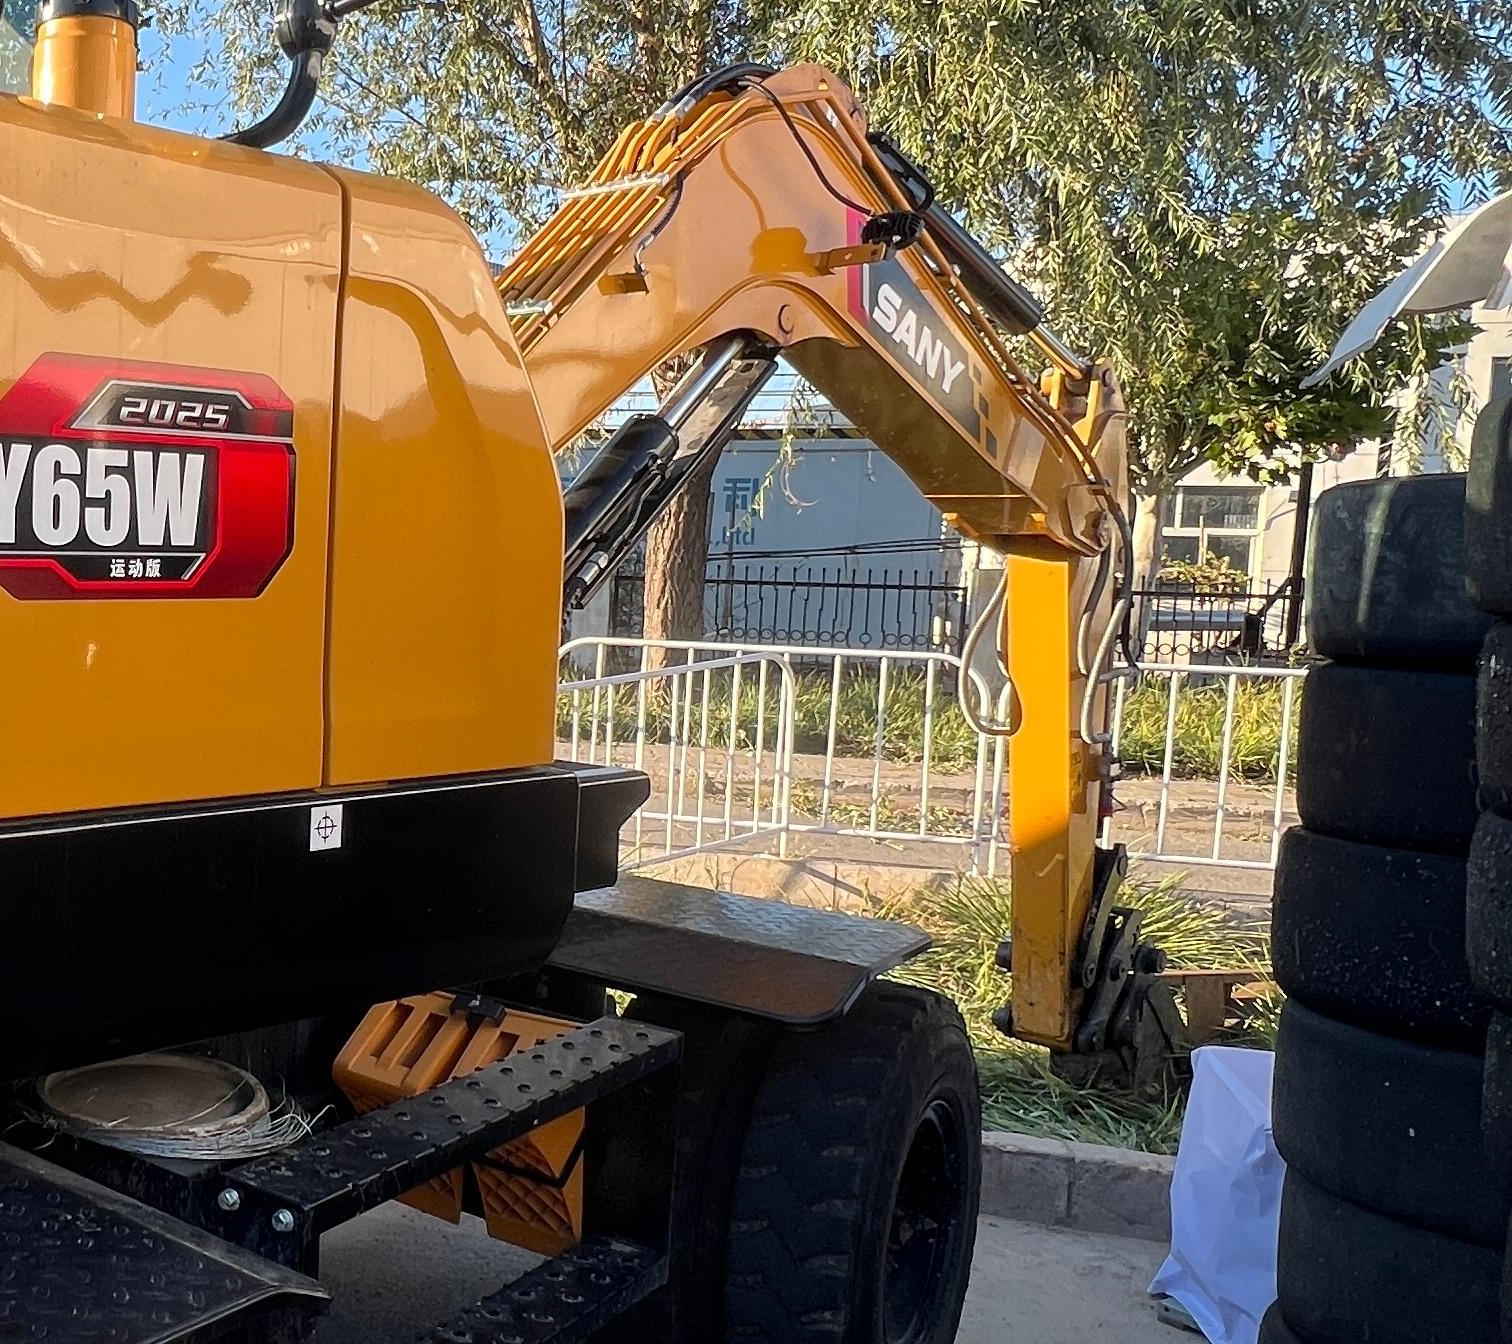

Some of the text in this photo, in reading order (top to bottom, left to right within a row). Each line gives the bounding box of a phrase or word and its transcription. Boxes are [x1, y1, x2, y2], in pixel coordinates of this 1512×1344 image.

[872, 283, 966, 394] SANY
[119, 396, 232, 430] 2025
[109, 558, 162, 579] 运动版
